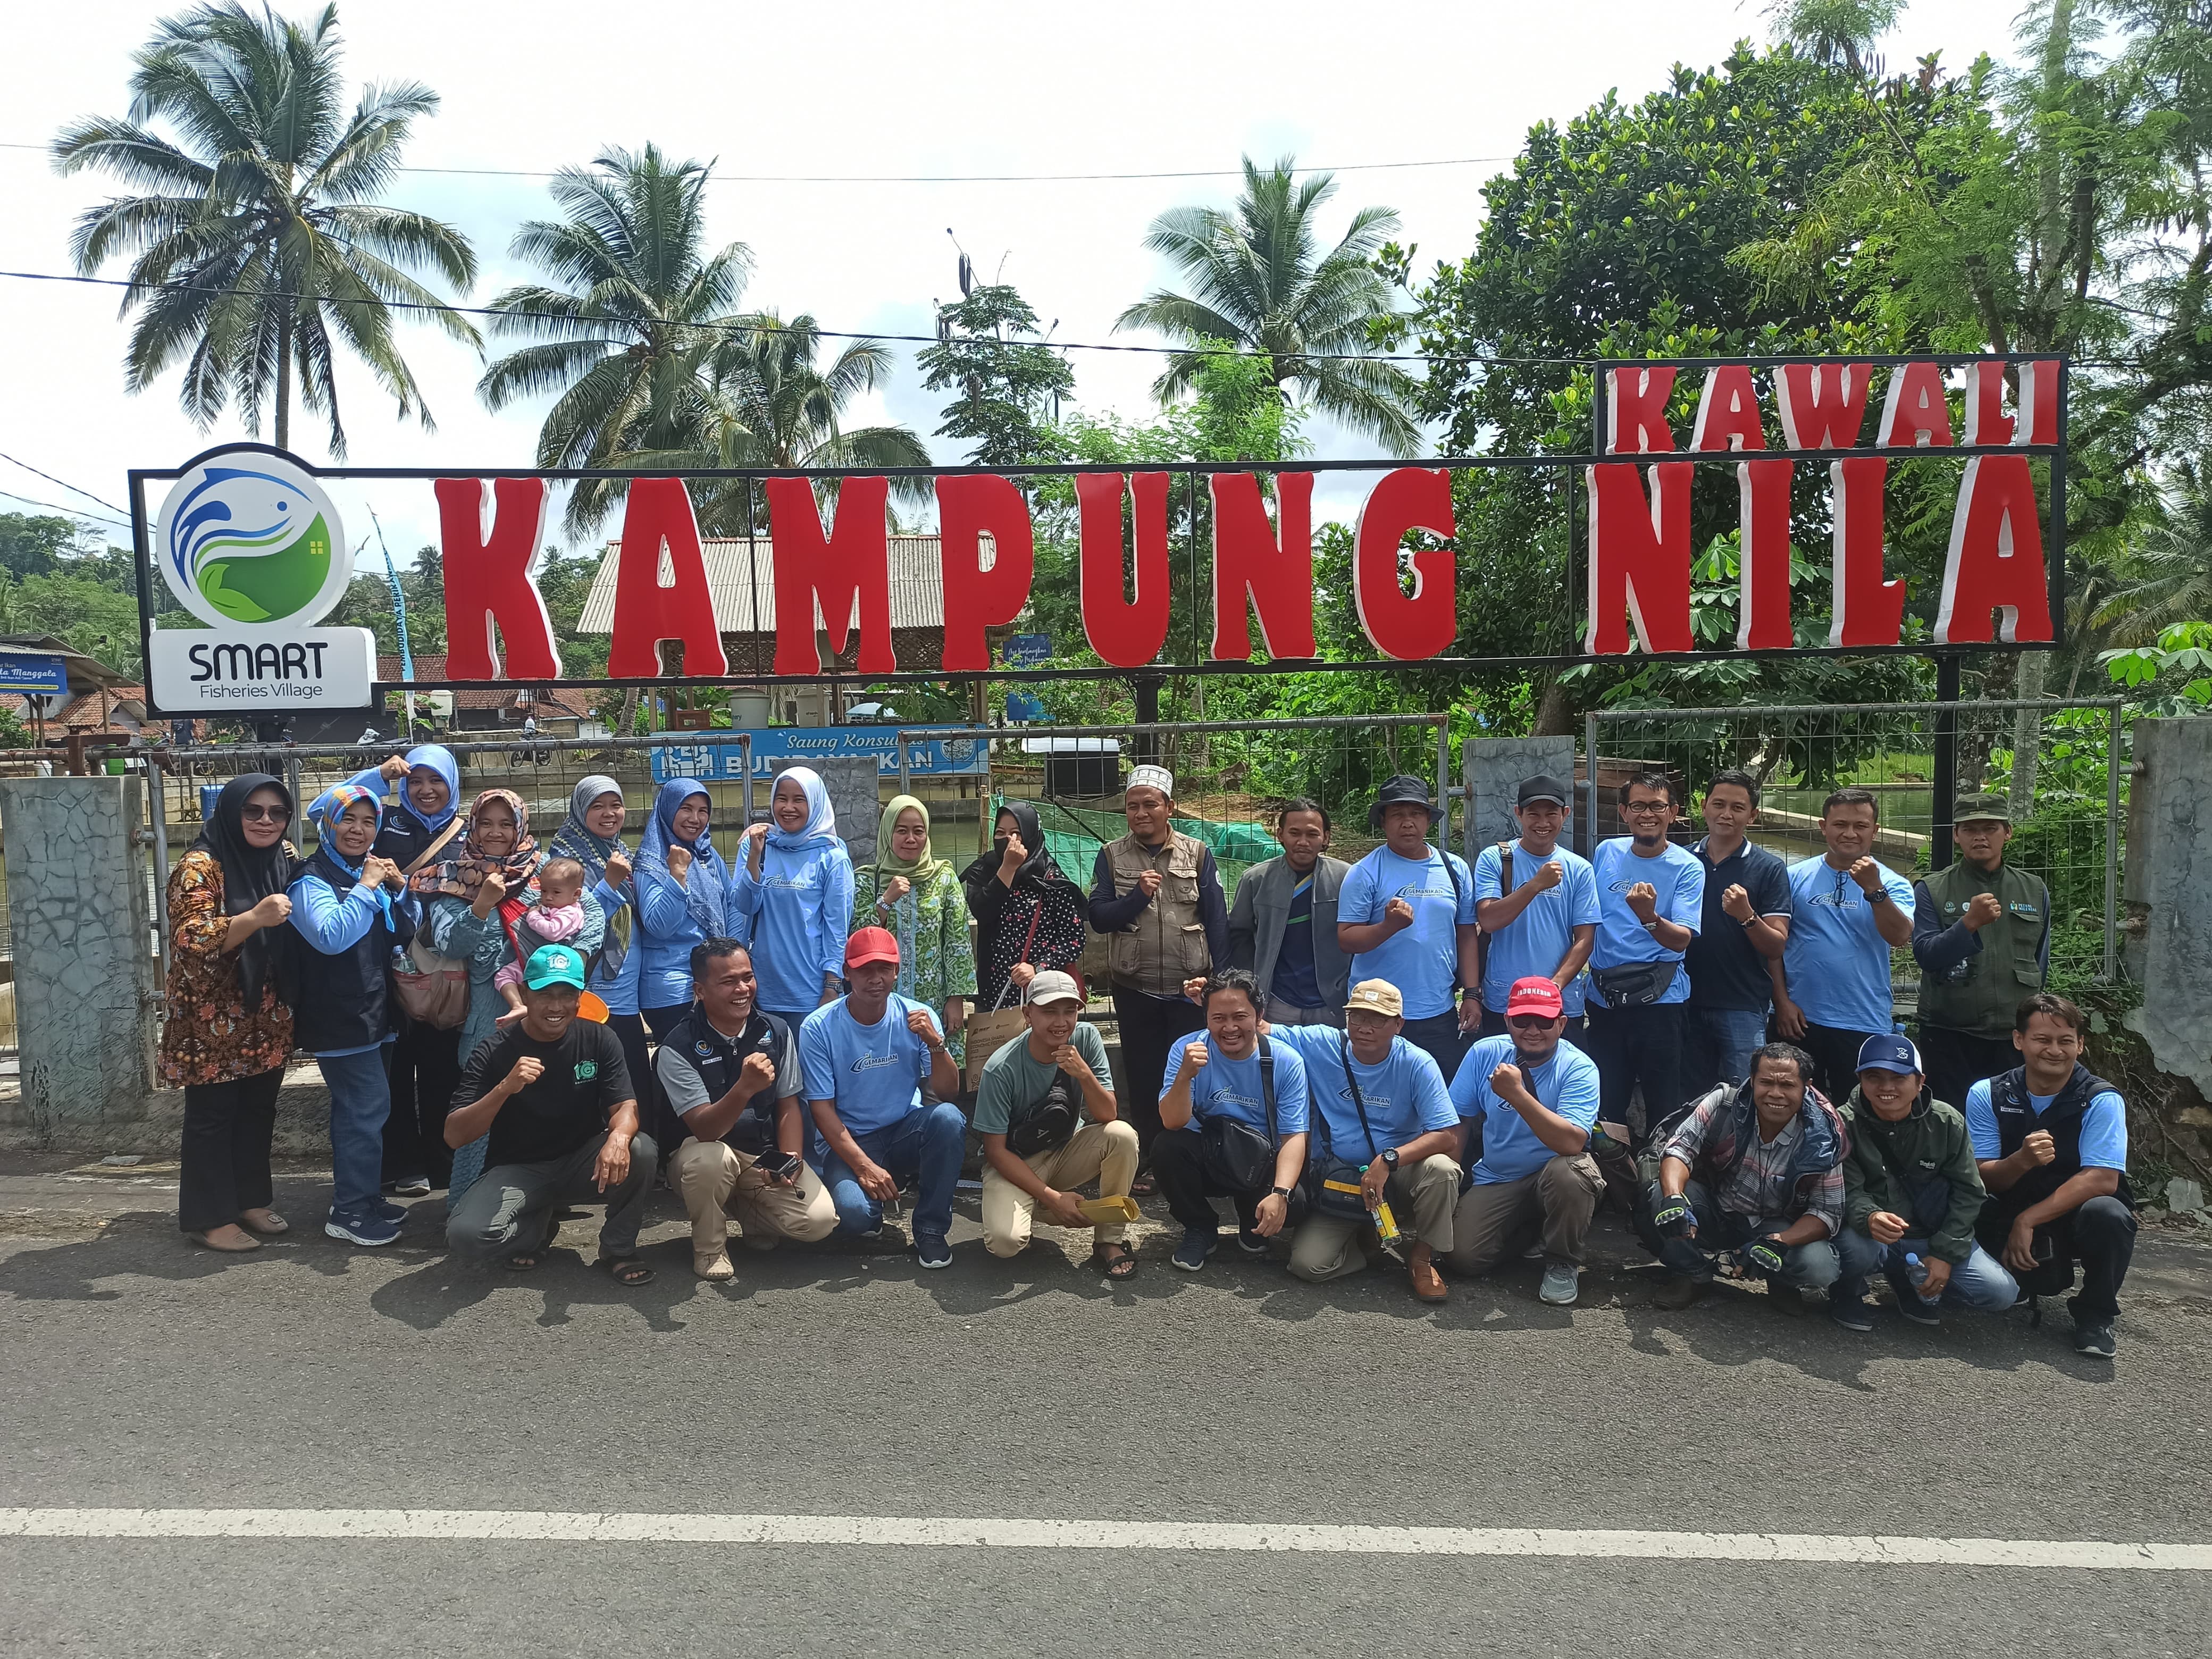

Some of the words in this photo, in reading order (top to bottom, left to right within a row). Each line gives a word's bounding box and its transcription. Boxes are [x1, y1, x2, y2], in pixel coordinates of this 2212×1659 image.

[1606, 361, 2061, 455] KAWALI
[434, 467, 1456, 680] KAMPUNG
[1585, 455, 2054, 655] NILA
[189, 642, 328, 681] SMART
[11, 668, 57, 679] Manggala
[200, 683, 268, 698] Fisheries
[270, 683, 323, 699] Village
[787, 734, 840, 751] Saung
[1517, 987, 1552, 998] INDONESIA
[1222, 1093, 1258, 1104] GEMARIKAN
[1359, 1093, 1390, 1104] EMARIKAN
